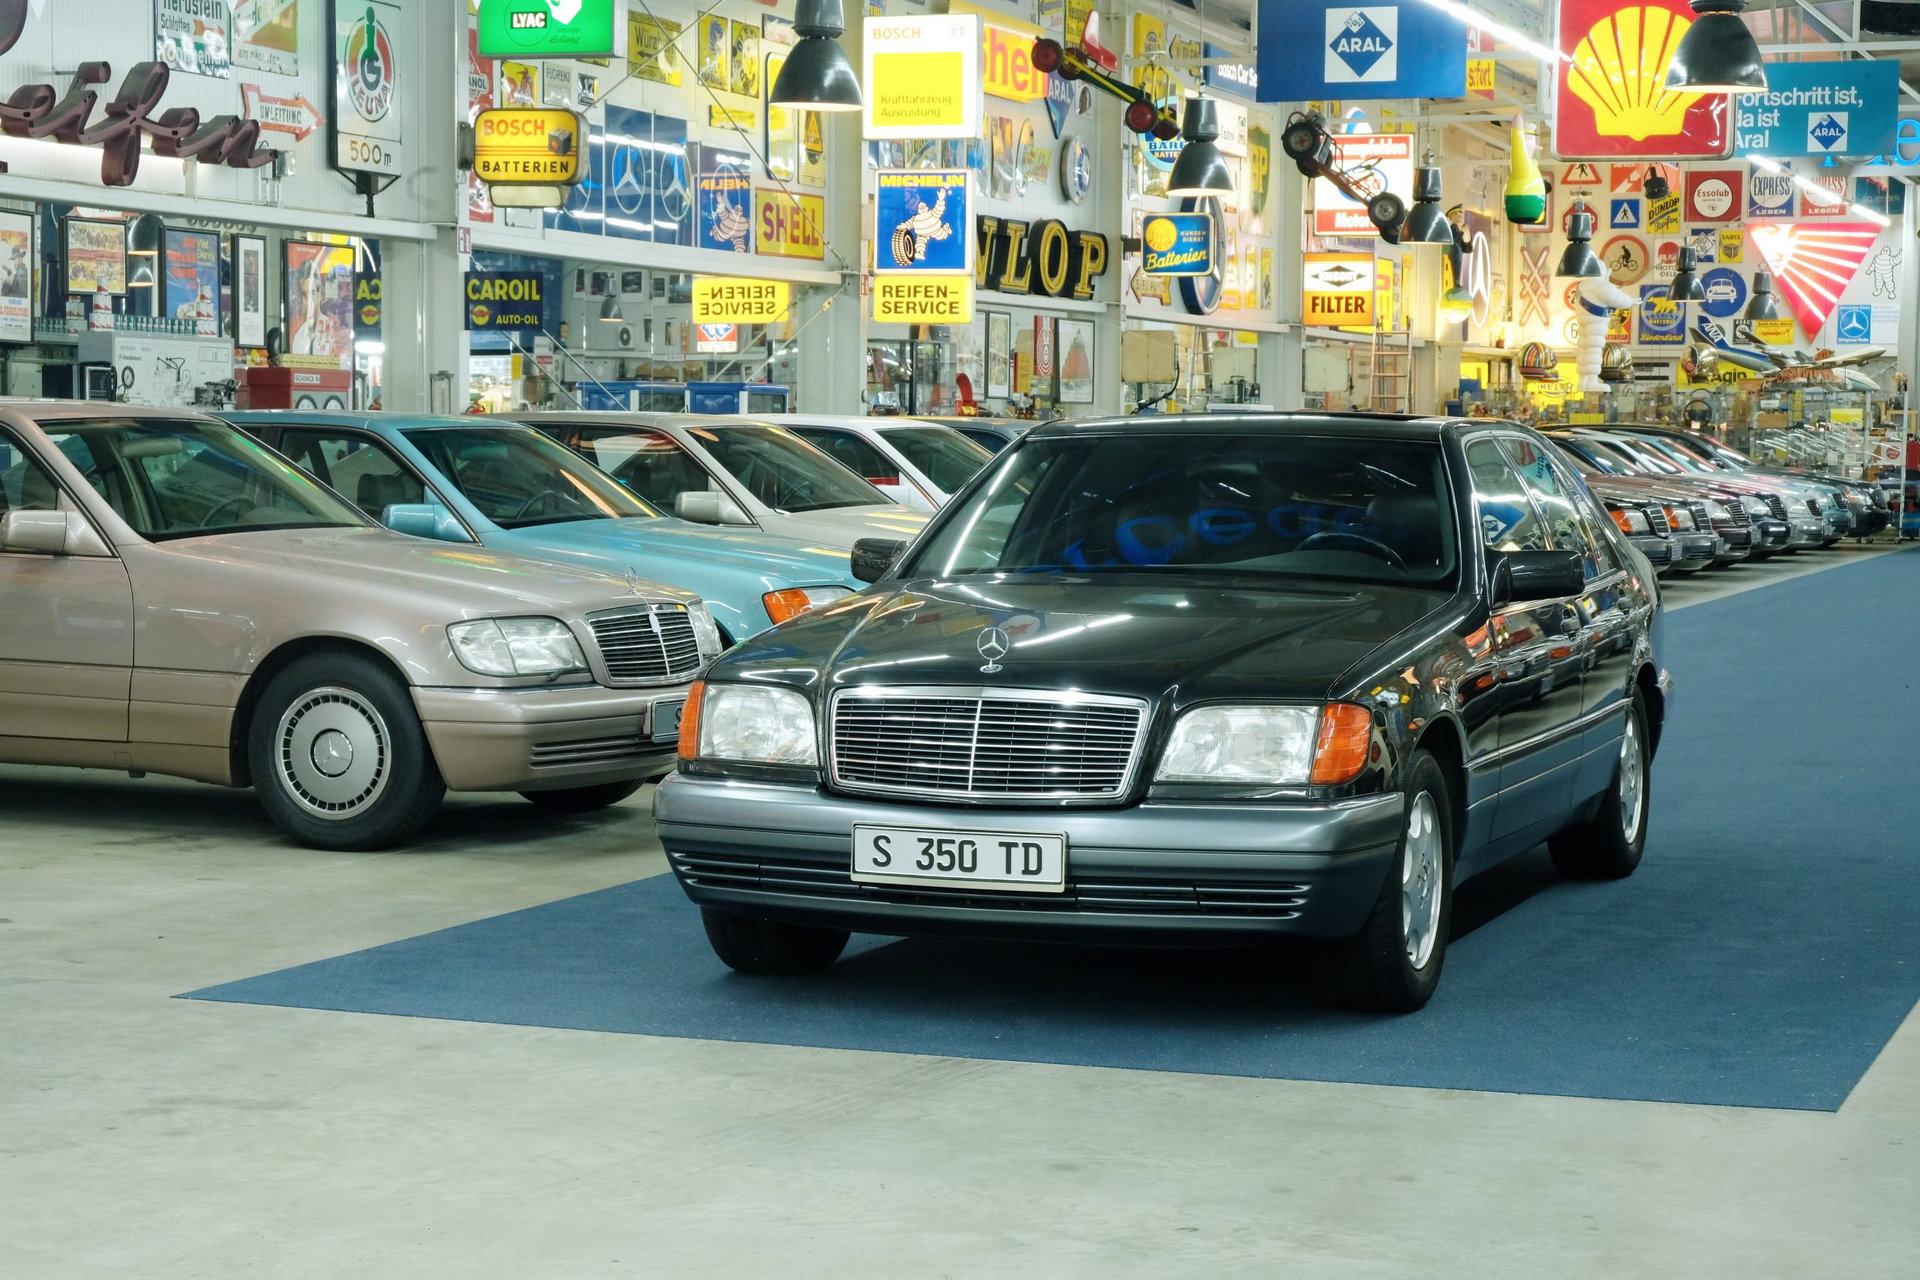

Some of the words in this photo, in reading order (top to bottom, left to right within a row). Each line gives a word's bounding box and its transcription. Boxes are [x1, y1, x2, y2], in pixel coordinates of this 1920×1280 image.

[512, 13, 547, 28] LYAC
[873, 28, 921, 39] BOSCH
[1337, 37, 1386, 53] ARAL
[983, 27, 1048, 97] hell
[546, 68, 571, 83] FLORENZ
[1238, 64, 1248, 84] Car
[351, 77, 390, 115] LEUNA
[1048, 80, 1072, 101] ARAL
[1738, 87, 1831, 107] ortschritt
[1834, 86, 1864, 109] ist,
[0, 61, 278, 187] eifen
[260, 104, 302, 125] UMLEITUNG
[1757, 109, 1780, 128] ist
[483, 119, 546, 136] BOSCH
[1813, 128, 1842, 137] ARAL
[350, 140, 382, 165] 500
[482, 161, 569, 174] BATTERIEN
[1249, 144, 1269, 193] BP
[880, 174, 965, 187] MICHELIN
[1753, 176, 1791, 197] EXPRESS
[1697, 189, 1730, 198] Essolub
[1648, 197, 1680, 221] DUNLOP
[762, 202, 819, 247] SHELL
[1145, 248, 1207, 271] Batterien
[467, 278, 541, 301] CAROIL
[882, 285, 959, 298] REIFEN-
[882, 301, 960, 315] SERVICE
[1311, 296, 1366, 313] FILTER
[496, 314, 539, 325] AUTO-OIL
[1701, 322, 1723, 343] ANA
[872, 834, 893, 868] S
[915, 837, 978, 873] 350
[998, 841, 1043, 876] TD
